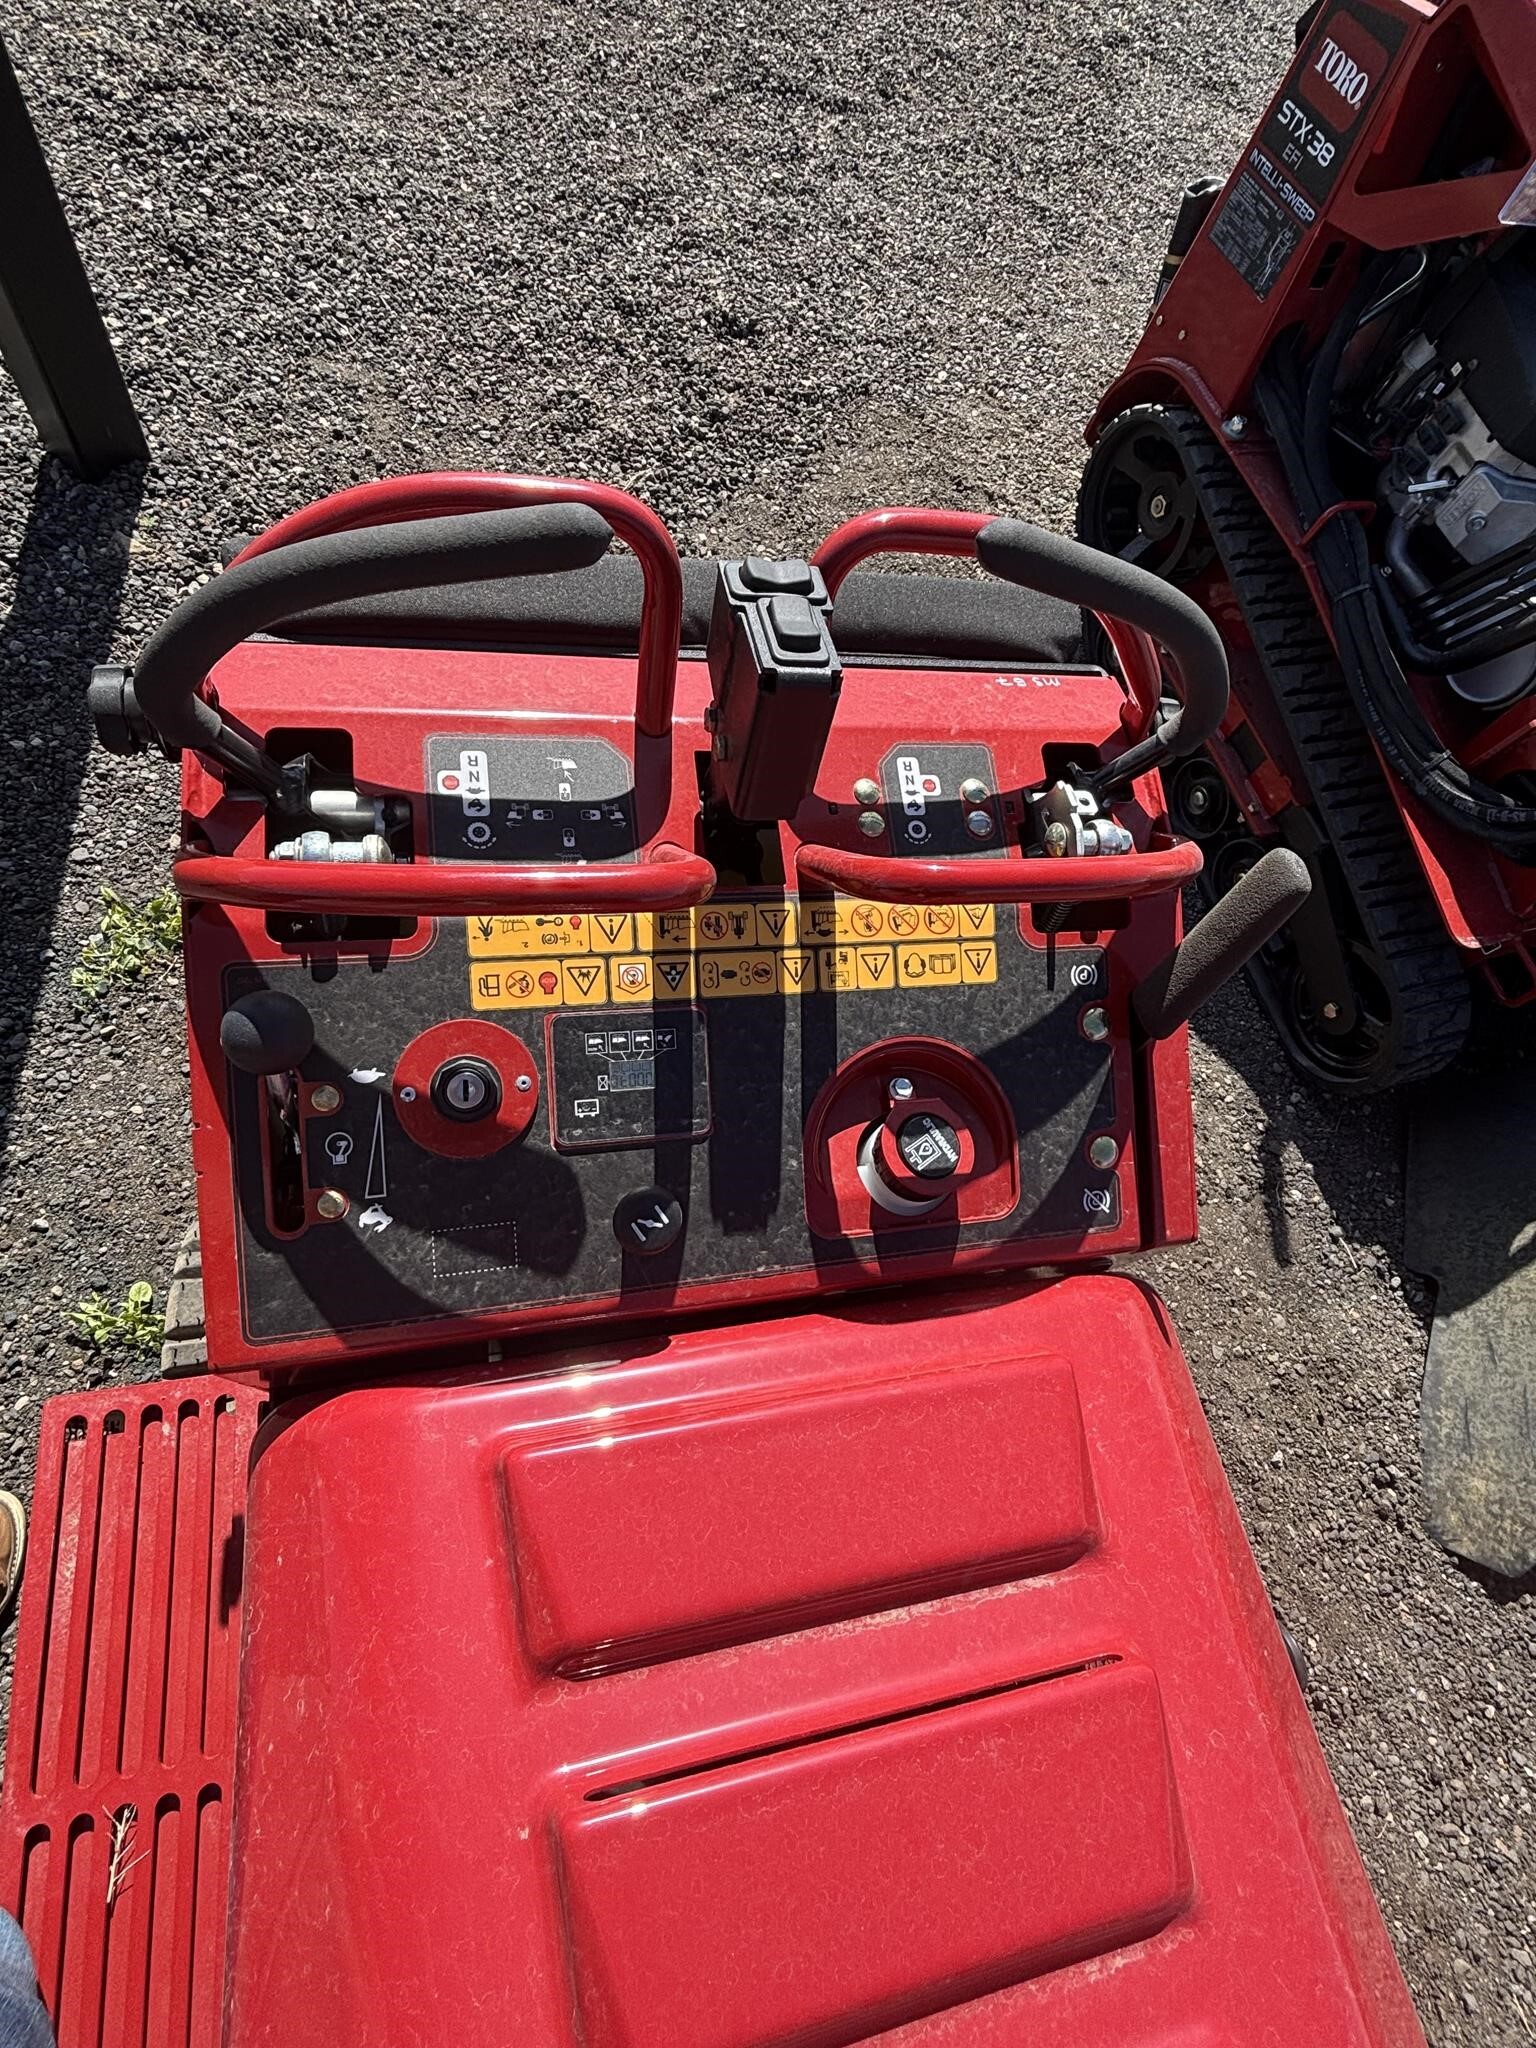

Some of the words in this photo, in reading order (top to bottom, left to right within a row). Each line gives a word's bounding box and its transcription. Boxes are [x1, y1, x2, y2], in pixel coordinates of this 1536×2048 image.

[1314, 37, 1369, 104] TORO
[1281, 142, 1304, 171] EFI
[469, 770, 480, 782] N
[904, 774, 915, 785] N
